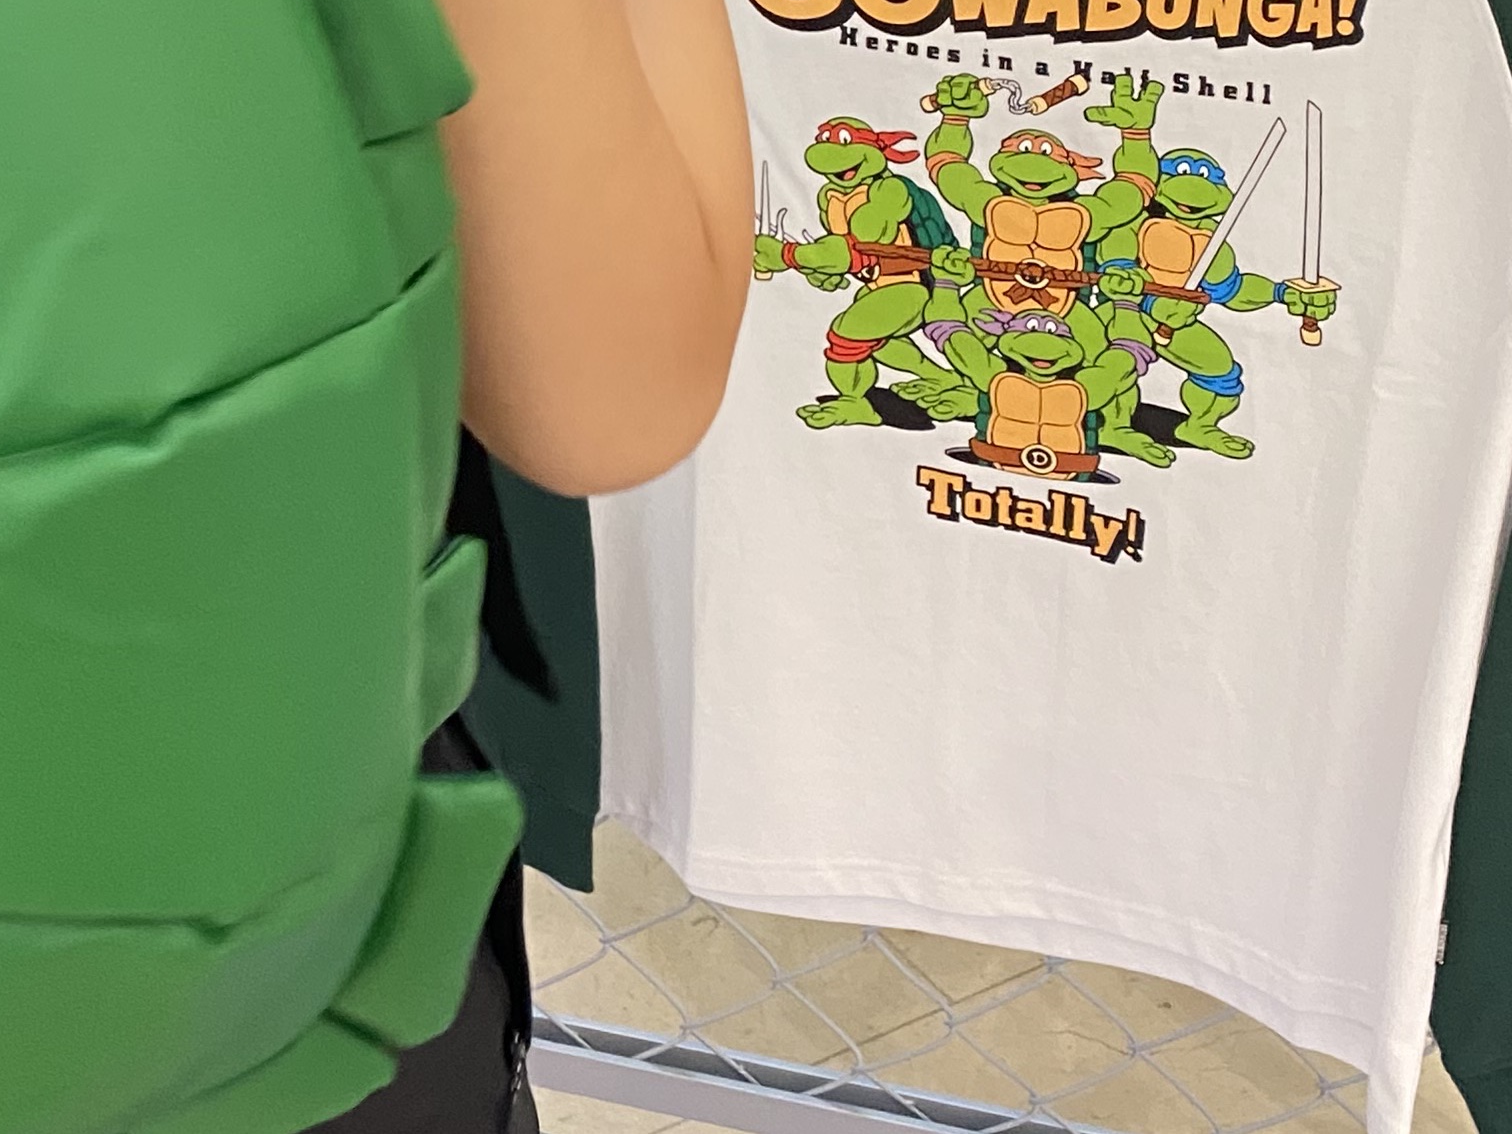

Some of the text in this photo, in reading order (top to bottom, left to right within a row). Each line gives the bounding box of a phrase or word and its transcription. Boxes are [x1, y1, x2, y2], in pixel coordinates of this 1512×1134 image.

[839, 25, 961, 63] Heroes
[982, 49, 1013, 72] in
[1035, 58, 1050, 77] a
[1172, 71, 1273, 105] Shell
[915, 464, 1147, 564] Totally!
